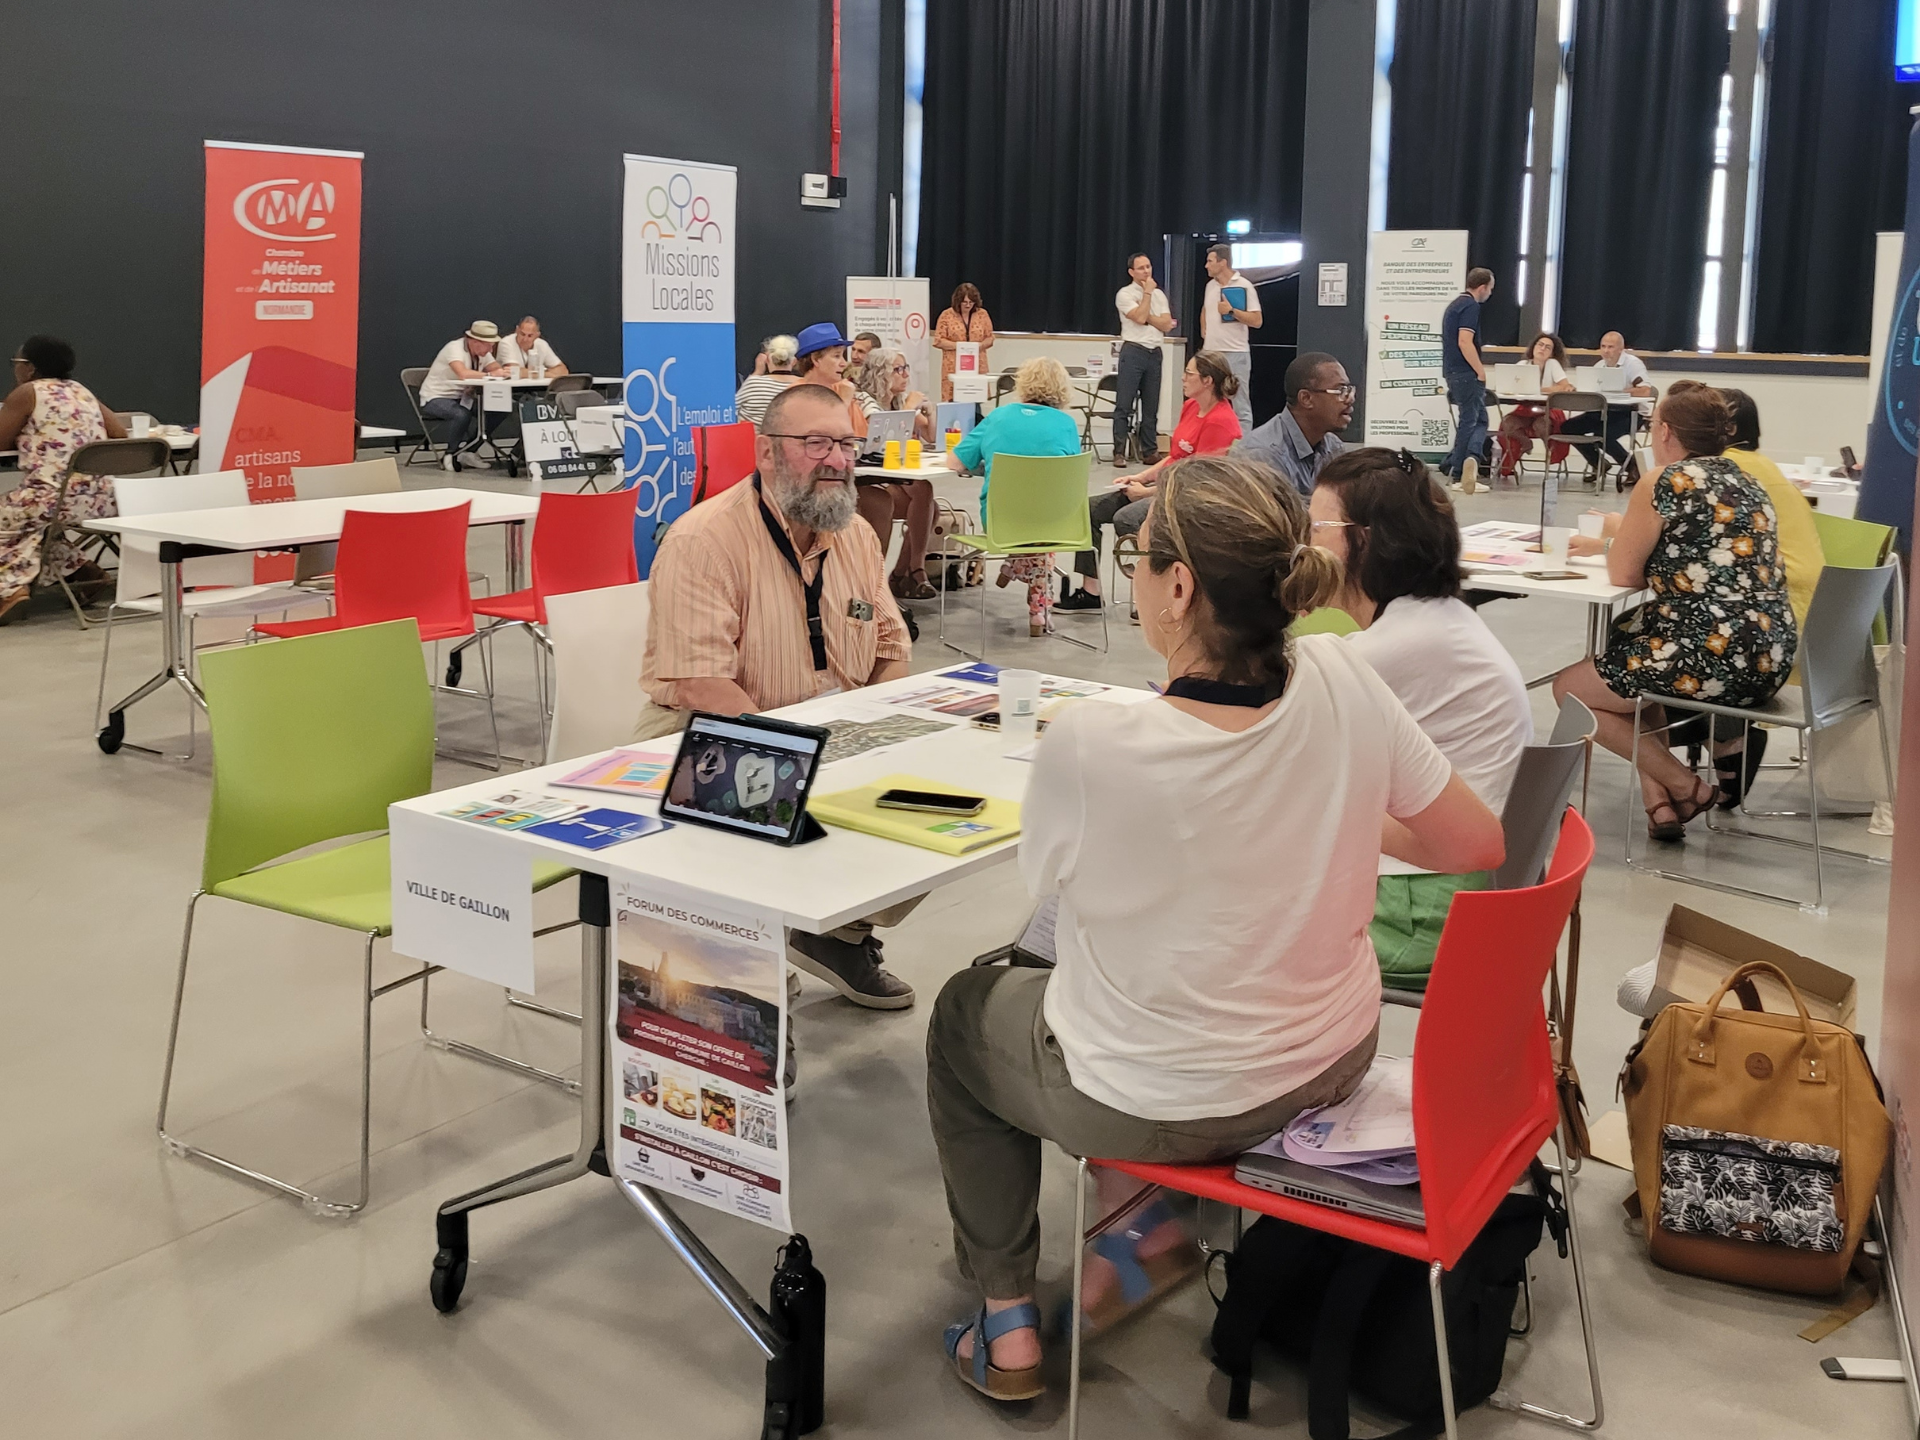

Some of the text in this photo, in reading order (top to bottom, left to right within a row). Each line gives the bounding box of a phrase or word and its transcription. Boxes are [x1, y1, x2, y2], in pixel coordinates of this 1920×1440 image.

[265, 249, 305, 257] Chambre
[646, 243, 720, 278] Missions
[262, 260, 323, 276] Métiers
[652, 278, 714, 311] Locales
[263, 304, 306, 316] NORMANDIE
[1393, 380, 1436, 388] CONSEILLER
[678, 405, 733, 426] L'emploi et
[552, 428, 578, 443] LOU
[235, 449, 301, 468] artisans
[258, 472, 272, 488] la
[406, 880, 510, 922] VILLE DE GAILLON
[626, 896, 760, 941] FORUM DES COMMERCES
[641, 1021, 660, 1034] POUR
[698, 1038, 712, 1050] SON
[734, 1052, 745, 1060] DE
[668, 1040, 677, 1048] LA
[711, 1053, 720, 1062] DE
[654, 1122, 672, 1134] VOUS
[673, 1128, 689, 1140] ÊTES
[710, 1159, 730, 1173] C'EST
